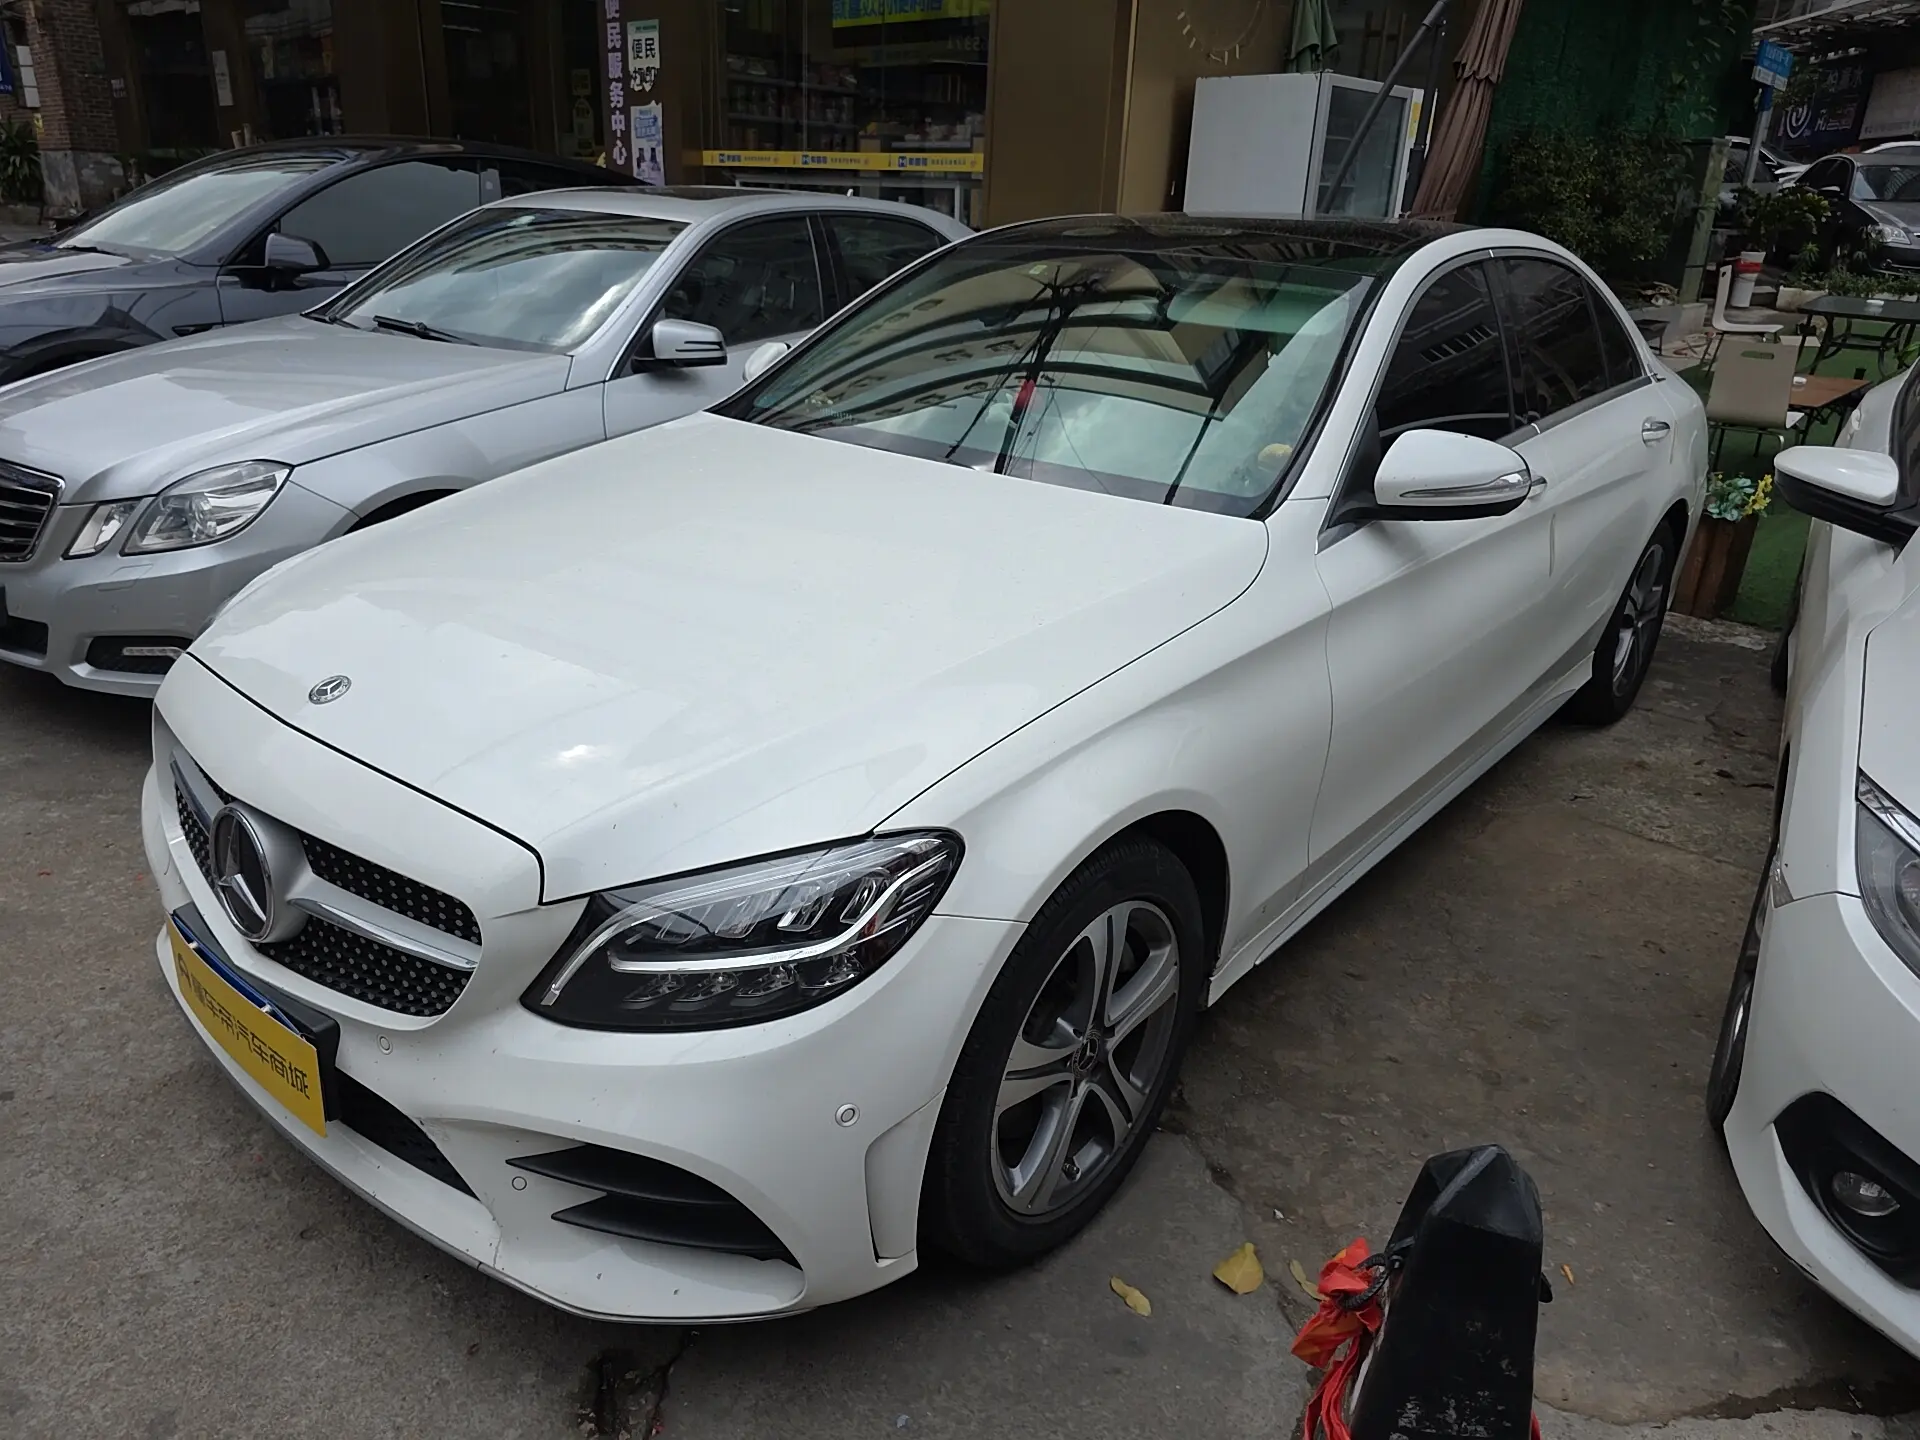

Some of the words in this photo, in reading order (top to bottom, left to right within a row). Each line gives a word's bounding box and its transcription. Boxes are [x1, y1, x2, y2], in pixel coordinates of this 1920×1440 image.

[605, 0, 628, 166] 便民服务中心
[631, 37, 656, 60] 便民
